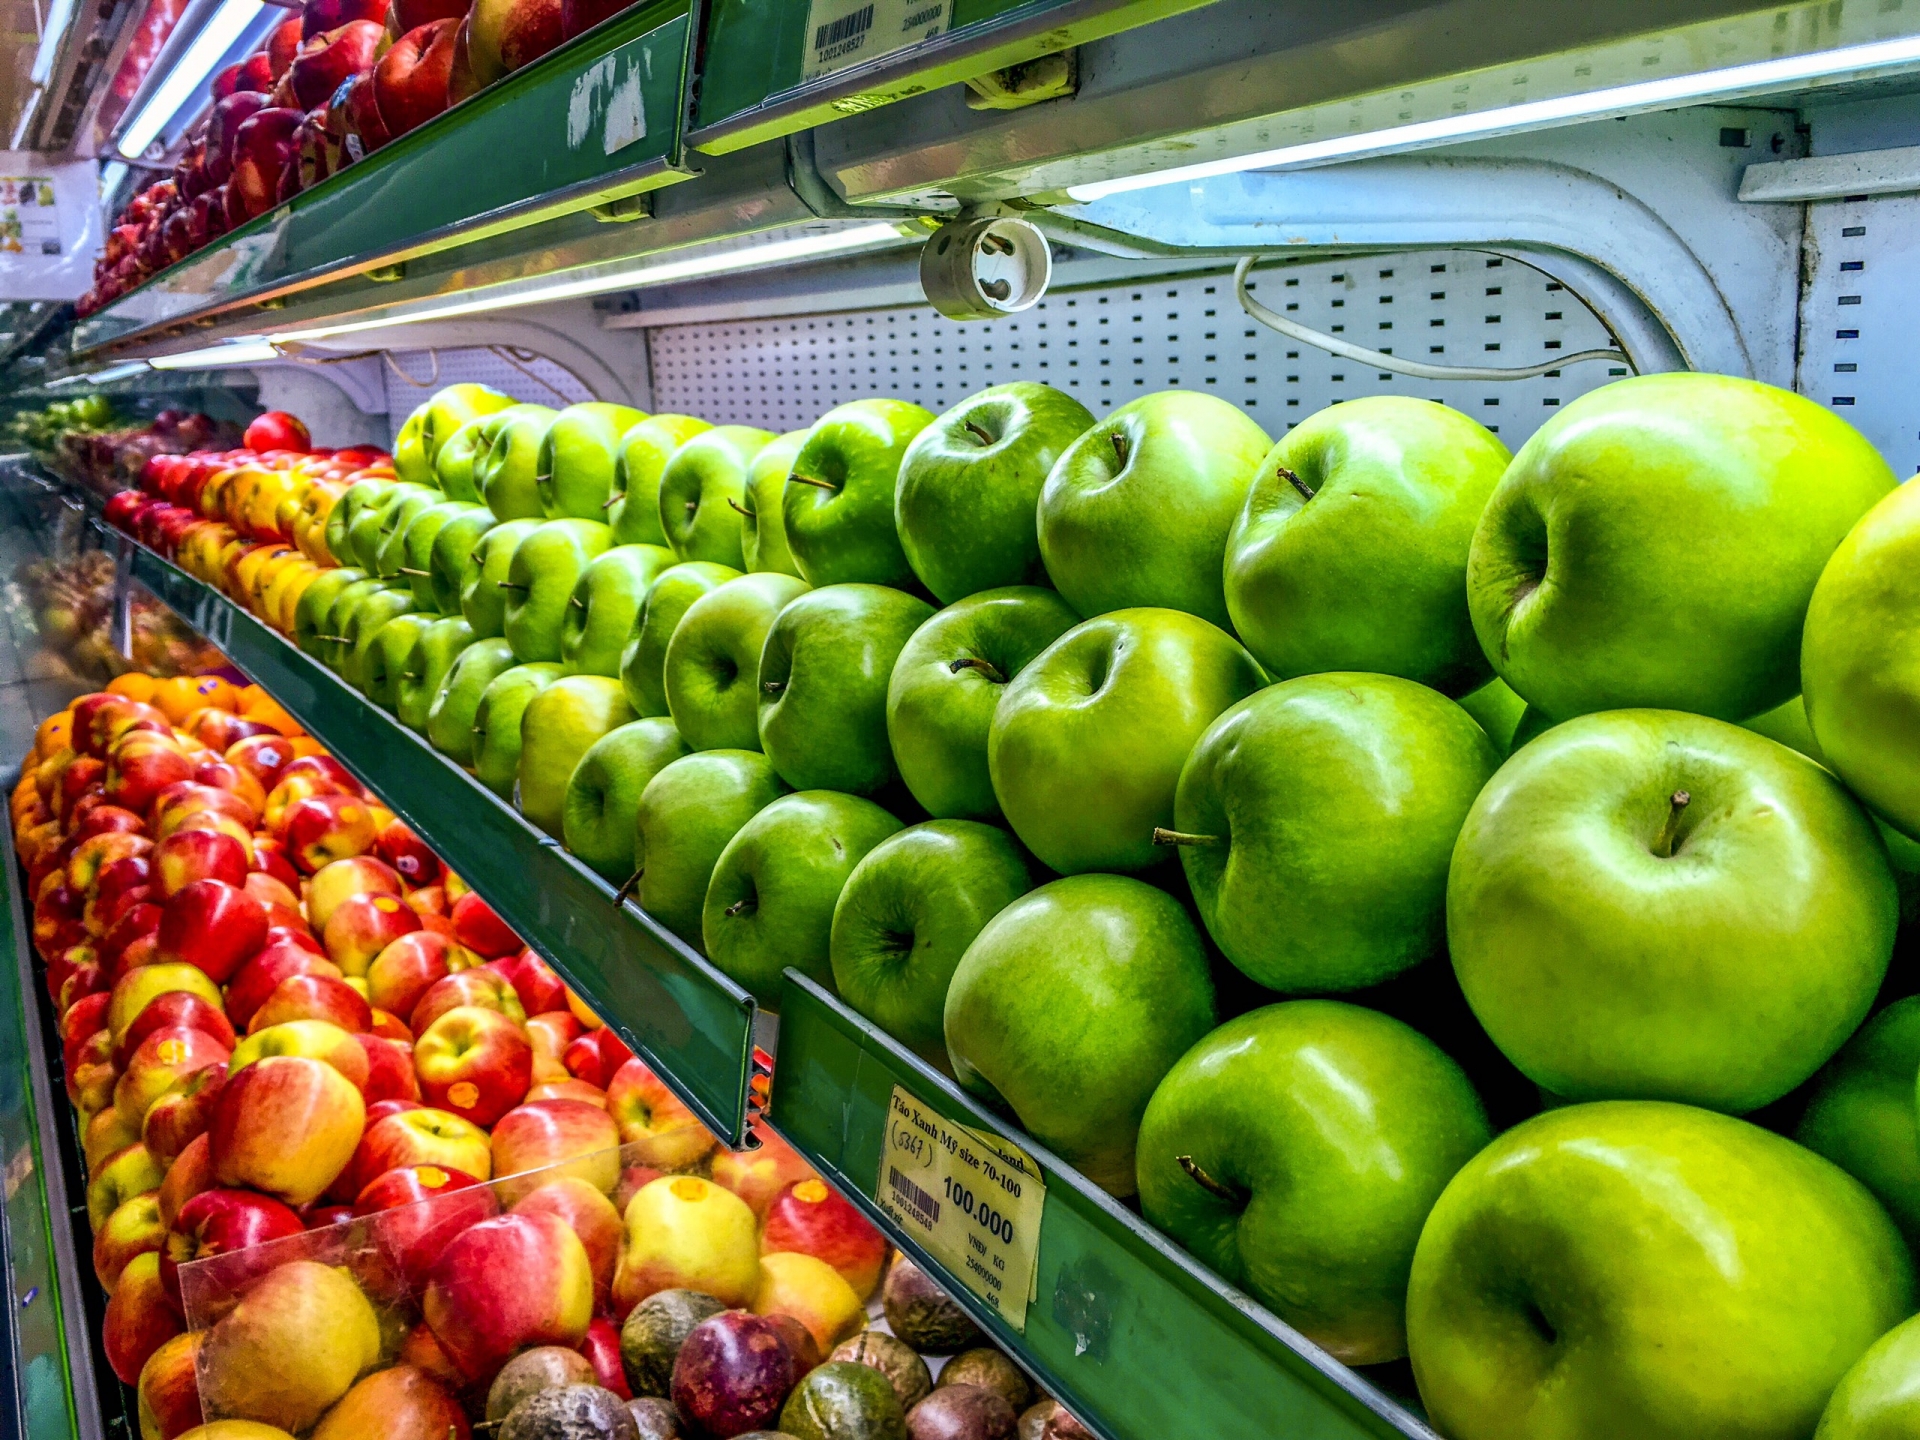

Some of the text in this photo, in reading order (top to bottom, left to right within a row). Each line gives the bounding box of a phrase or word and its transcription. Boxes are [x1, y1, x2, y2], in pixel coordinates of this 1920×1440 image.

[818, 34, 865, 62] 1001248527
[893, 1095, 1021, 1198] Táo Xanh Mỹ size 70-100
[892, 1191, 933, 1232] 1001248548
[944, 1176, 1013, 1244] 100.000
[993, 1254, 1005, 1271] KG
[986, 1292, 999, 1309] 468
